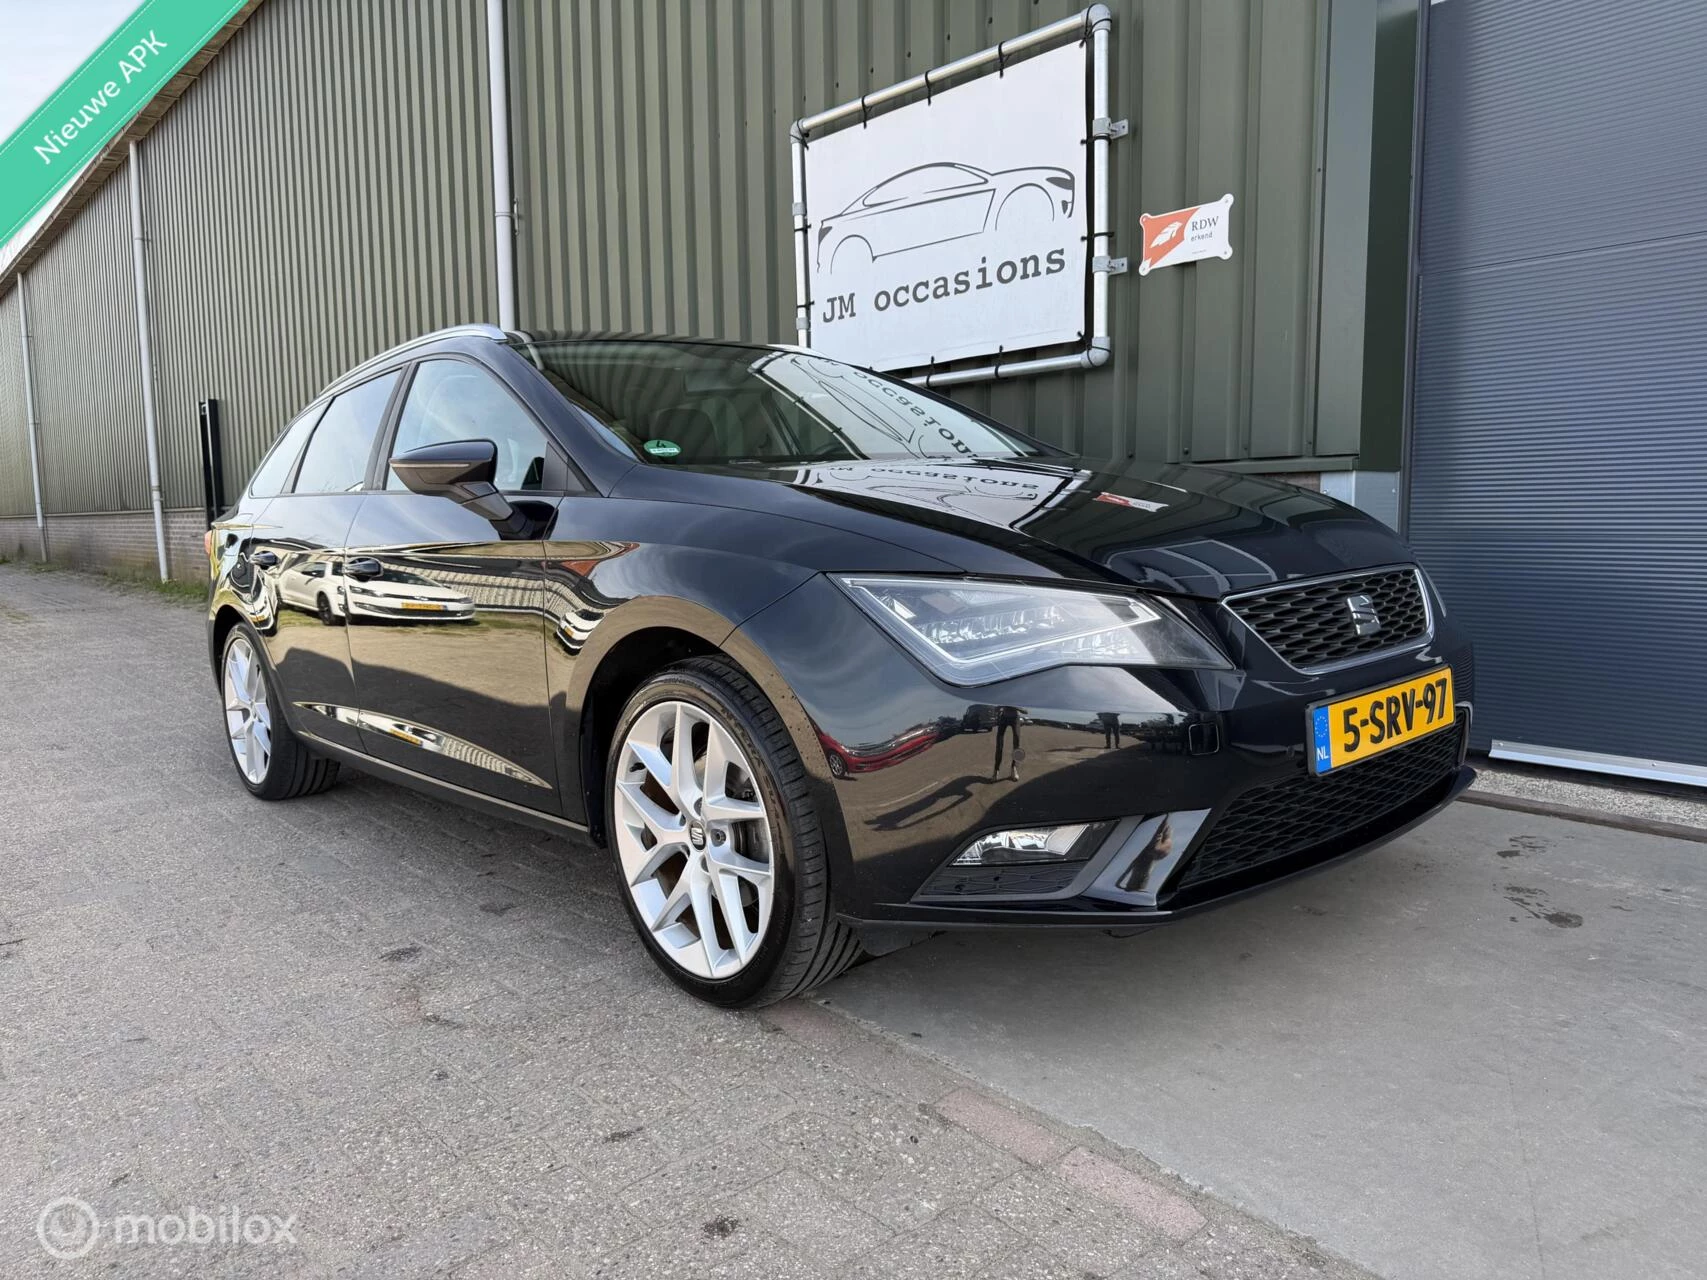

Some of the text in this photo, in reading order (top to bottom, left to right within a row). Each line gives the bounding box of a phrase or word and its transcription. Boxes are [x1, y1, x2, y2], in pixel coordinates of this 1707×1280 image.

[1190, 232, 1213, 242] erkend
[1191, 215, 1219, 232] RDW
[823, 248, 1066, 323] JM occasions
[1316, 677, 1448, 761] NL 5-SRV-97
